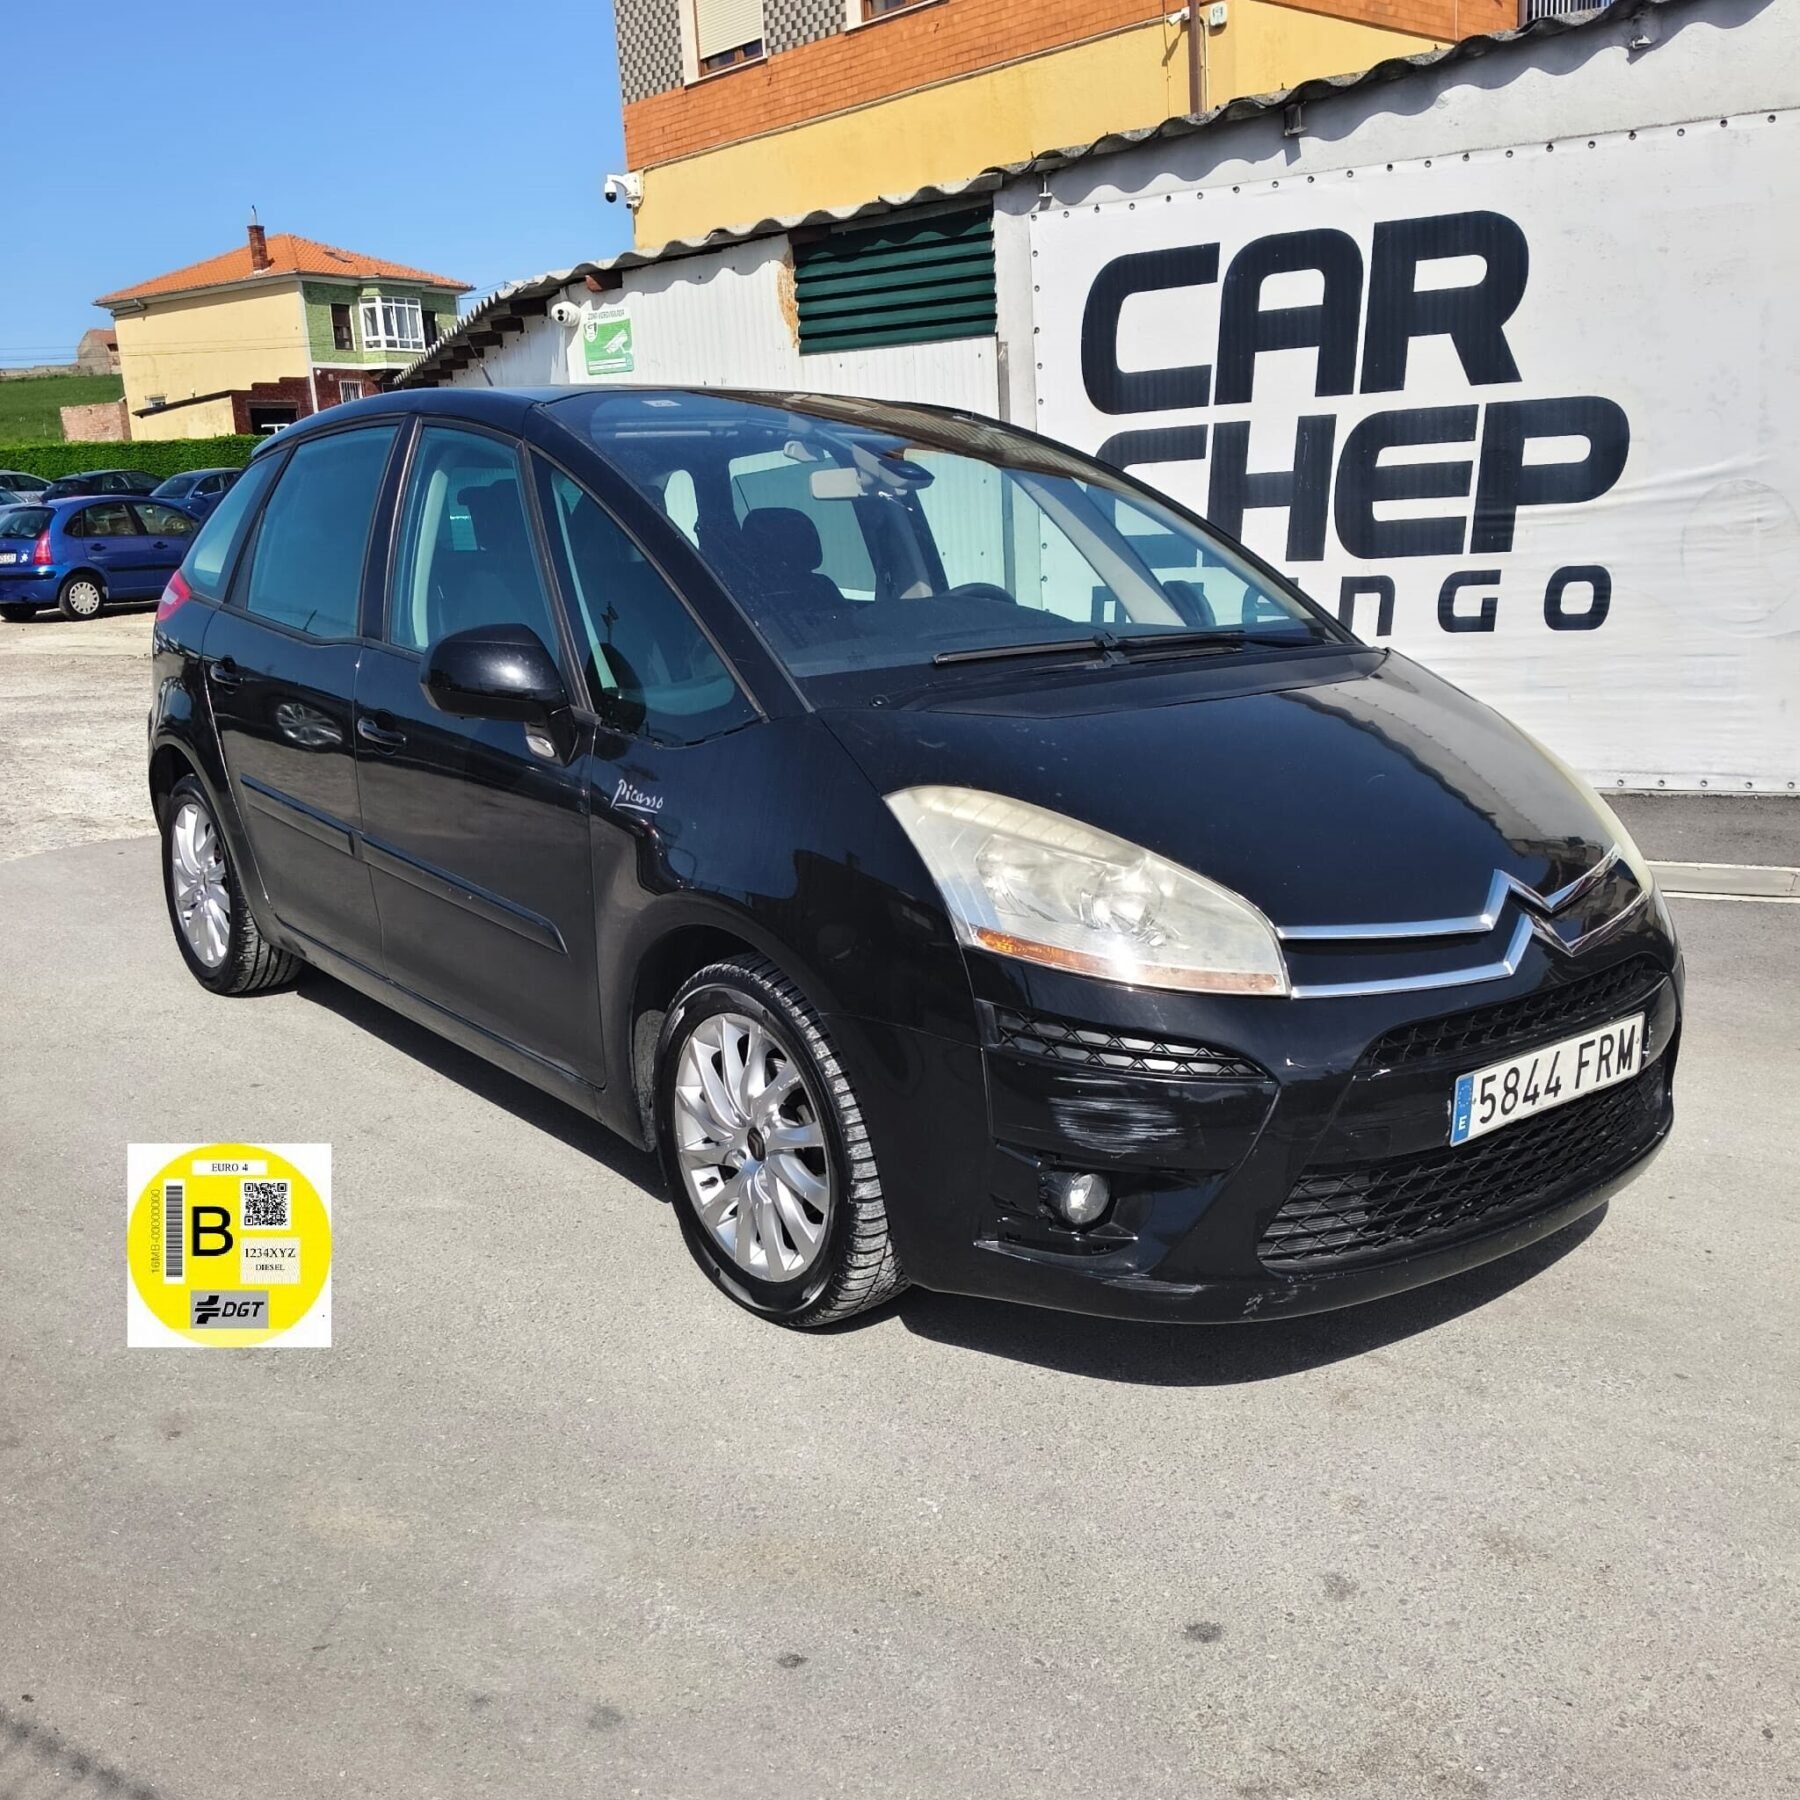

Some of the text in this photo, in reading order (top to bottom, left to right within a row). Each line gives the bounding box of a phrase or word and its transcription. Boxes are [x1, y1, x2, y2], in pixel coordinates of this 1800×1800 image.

[1081, 210, 1529, 415] CAR
[1085, 395, 1630, 570] CHEP
[1458, 1024, 1636, 1130] E 5844 FRM
